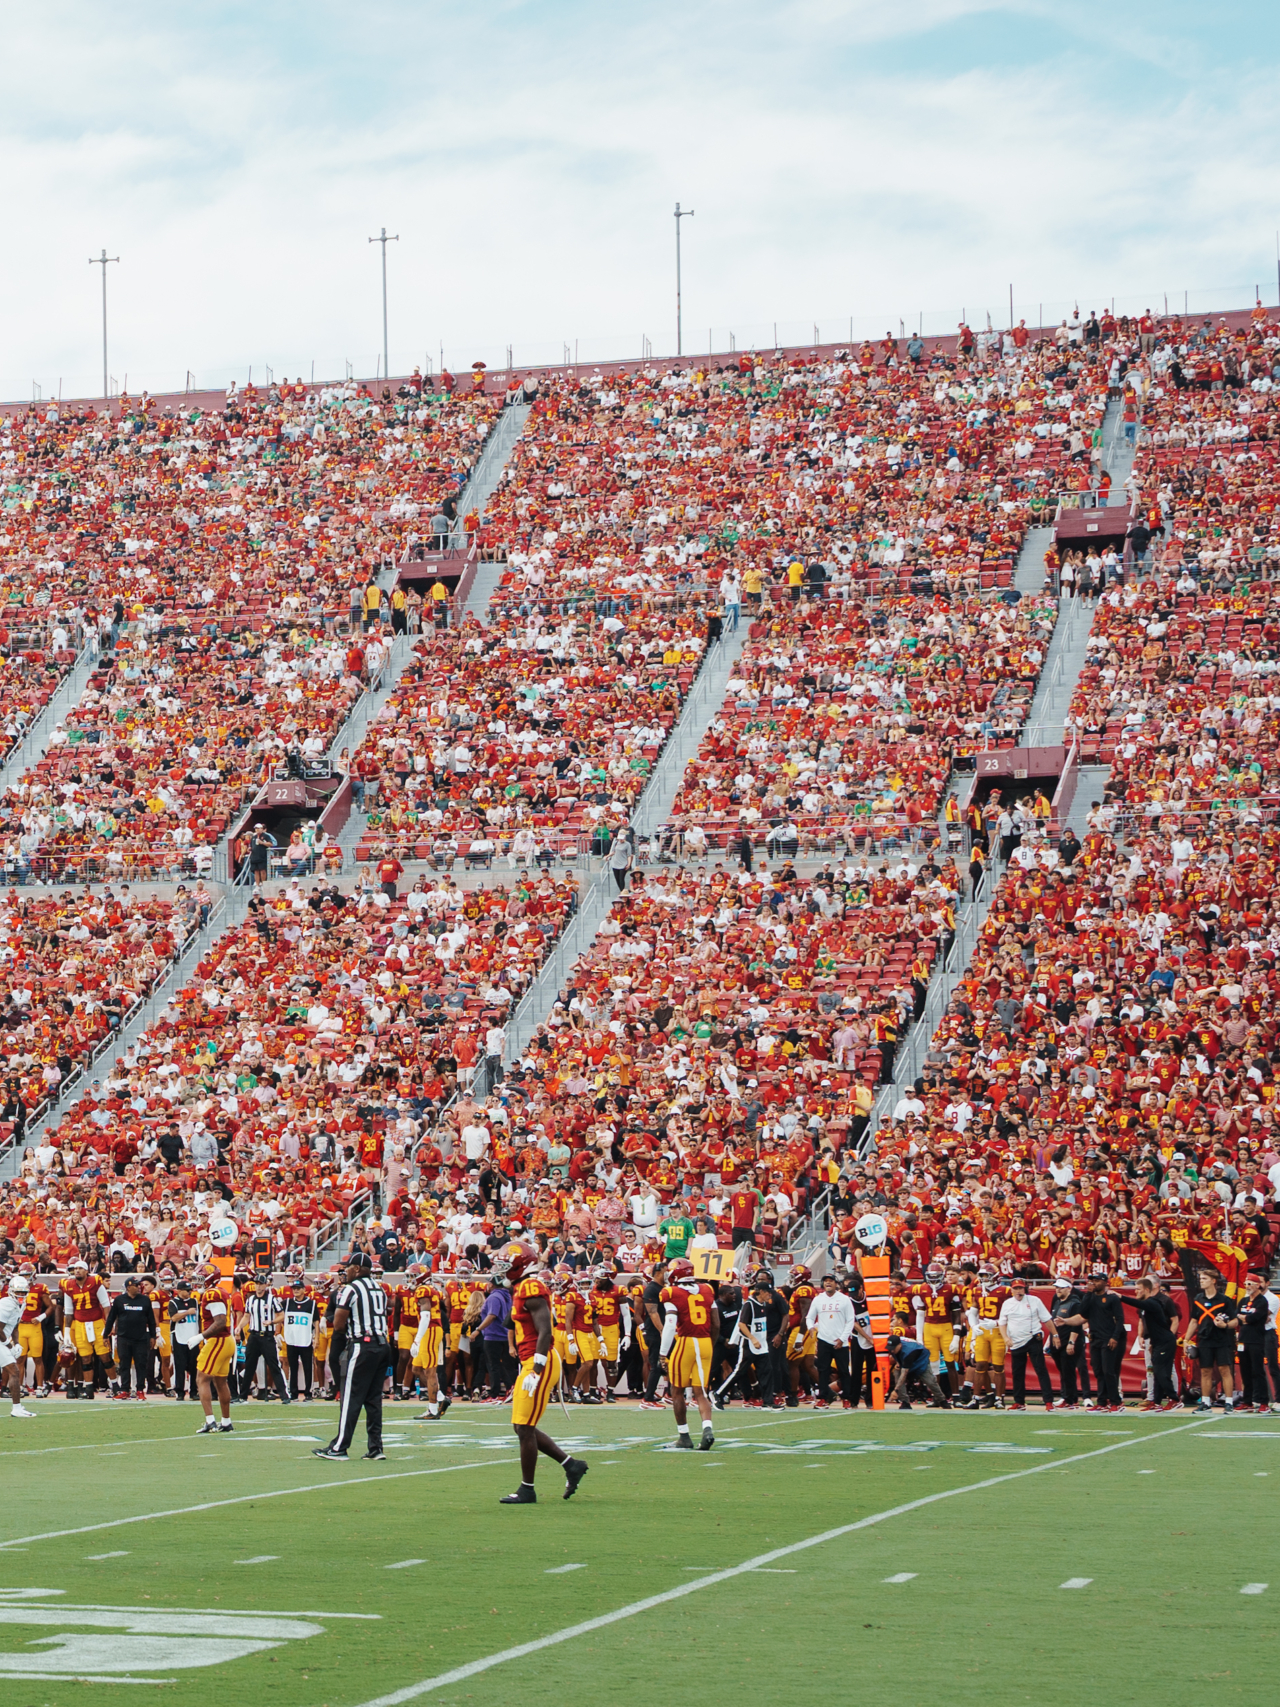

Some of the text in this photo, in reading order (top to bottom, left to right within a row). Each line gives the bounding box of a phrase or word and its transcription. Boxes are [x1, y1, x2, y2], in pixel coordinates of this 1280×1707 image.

[984, 759, 999, 770] 23
[275, 789, 288, 799] 22
[789, 977, 802, 989] 55
[1252, 1001, 1260, 1012] 6
[1149, 1027, 1156, 1038] 9
[364, 1139, 376, 1151] 33
[723, 1161, 734, 1171] 13
[640, 1203, 646, 1215] 1
[211, 1226, 233, 1241] B1G
[669, 1225, 685, 1240] 09
[858, 1223, 883, 1239] B1G
[1202, 1224, 1212, 1240] 2
[257, 1239, 270, 1268] 2
[622, 1252, 636, 1263] 55
[700, 1253, 724, 1275] 11
[1126, 1256, 1142, 1270] 80
[416, 1288, 426, 1298] 27
[524, 1282, 539, 1296] 16
[797, 1289, 808, 1297] 45
[73, 1293, 93, 1310] 71
[206, 1292, 216, 1301] 17
[371, 1290, 385, 1315] U
[451, 1291, 472, 1310] 49
[595, 1298, 615, 1316] 26
[687, 1294, 708, 1325] 6
[925, 1296, 947, 1316] 14
[978, 1297, 999, 1317] 15
[287, 1315, 309, 1326] B1G
[583, 1305, 593, 1324] 2
